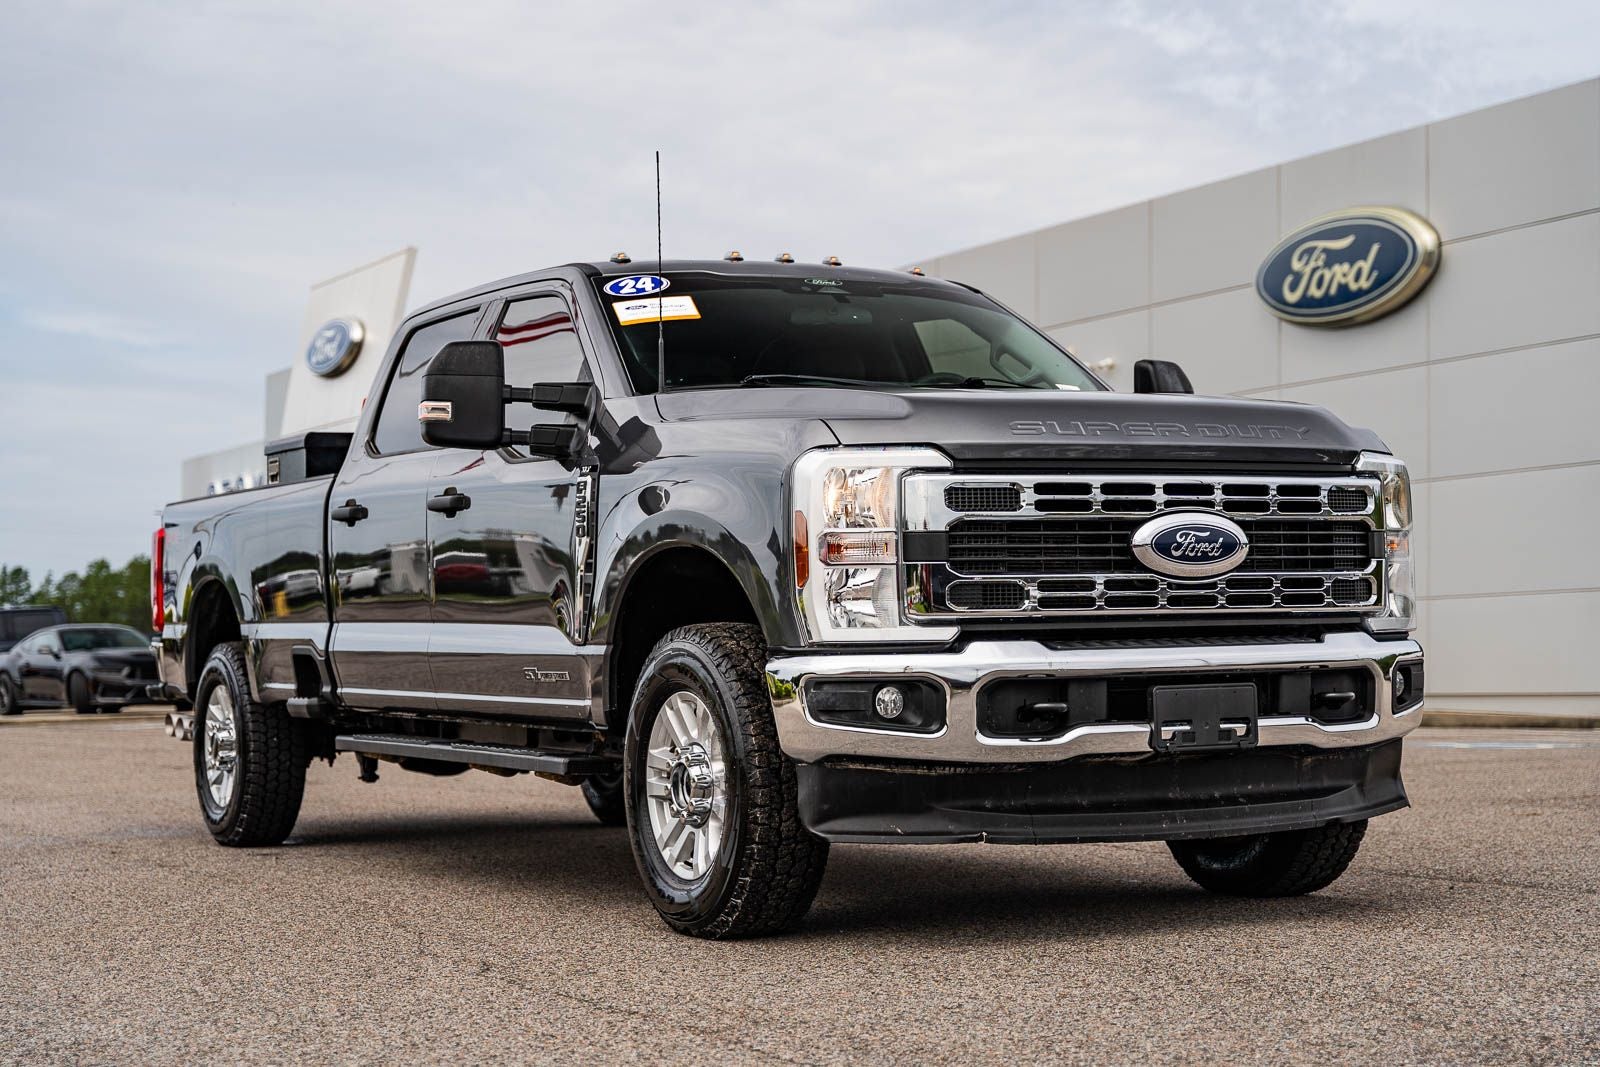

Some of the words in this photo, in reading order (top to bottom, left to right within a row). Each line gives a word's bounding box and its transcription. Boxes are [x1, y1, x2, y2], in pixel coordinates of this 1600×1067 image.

[1282, 234, 1381, 305] Ford
[618, 276, 656, 294] 24
[1008, 420, 1191, 438] SUPER
[1196, 422, 1311, 440] DUTY
[1170, 530, 1224, 557] Ford
